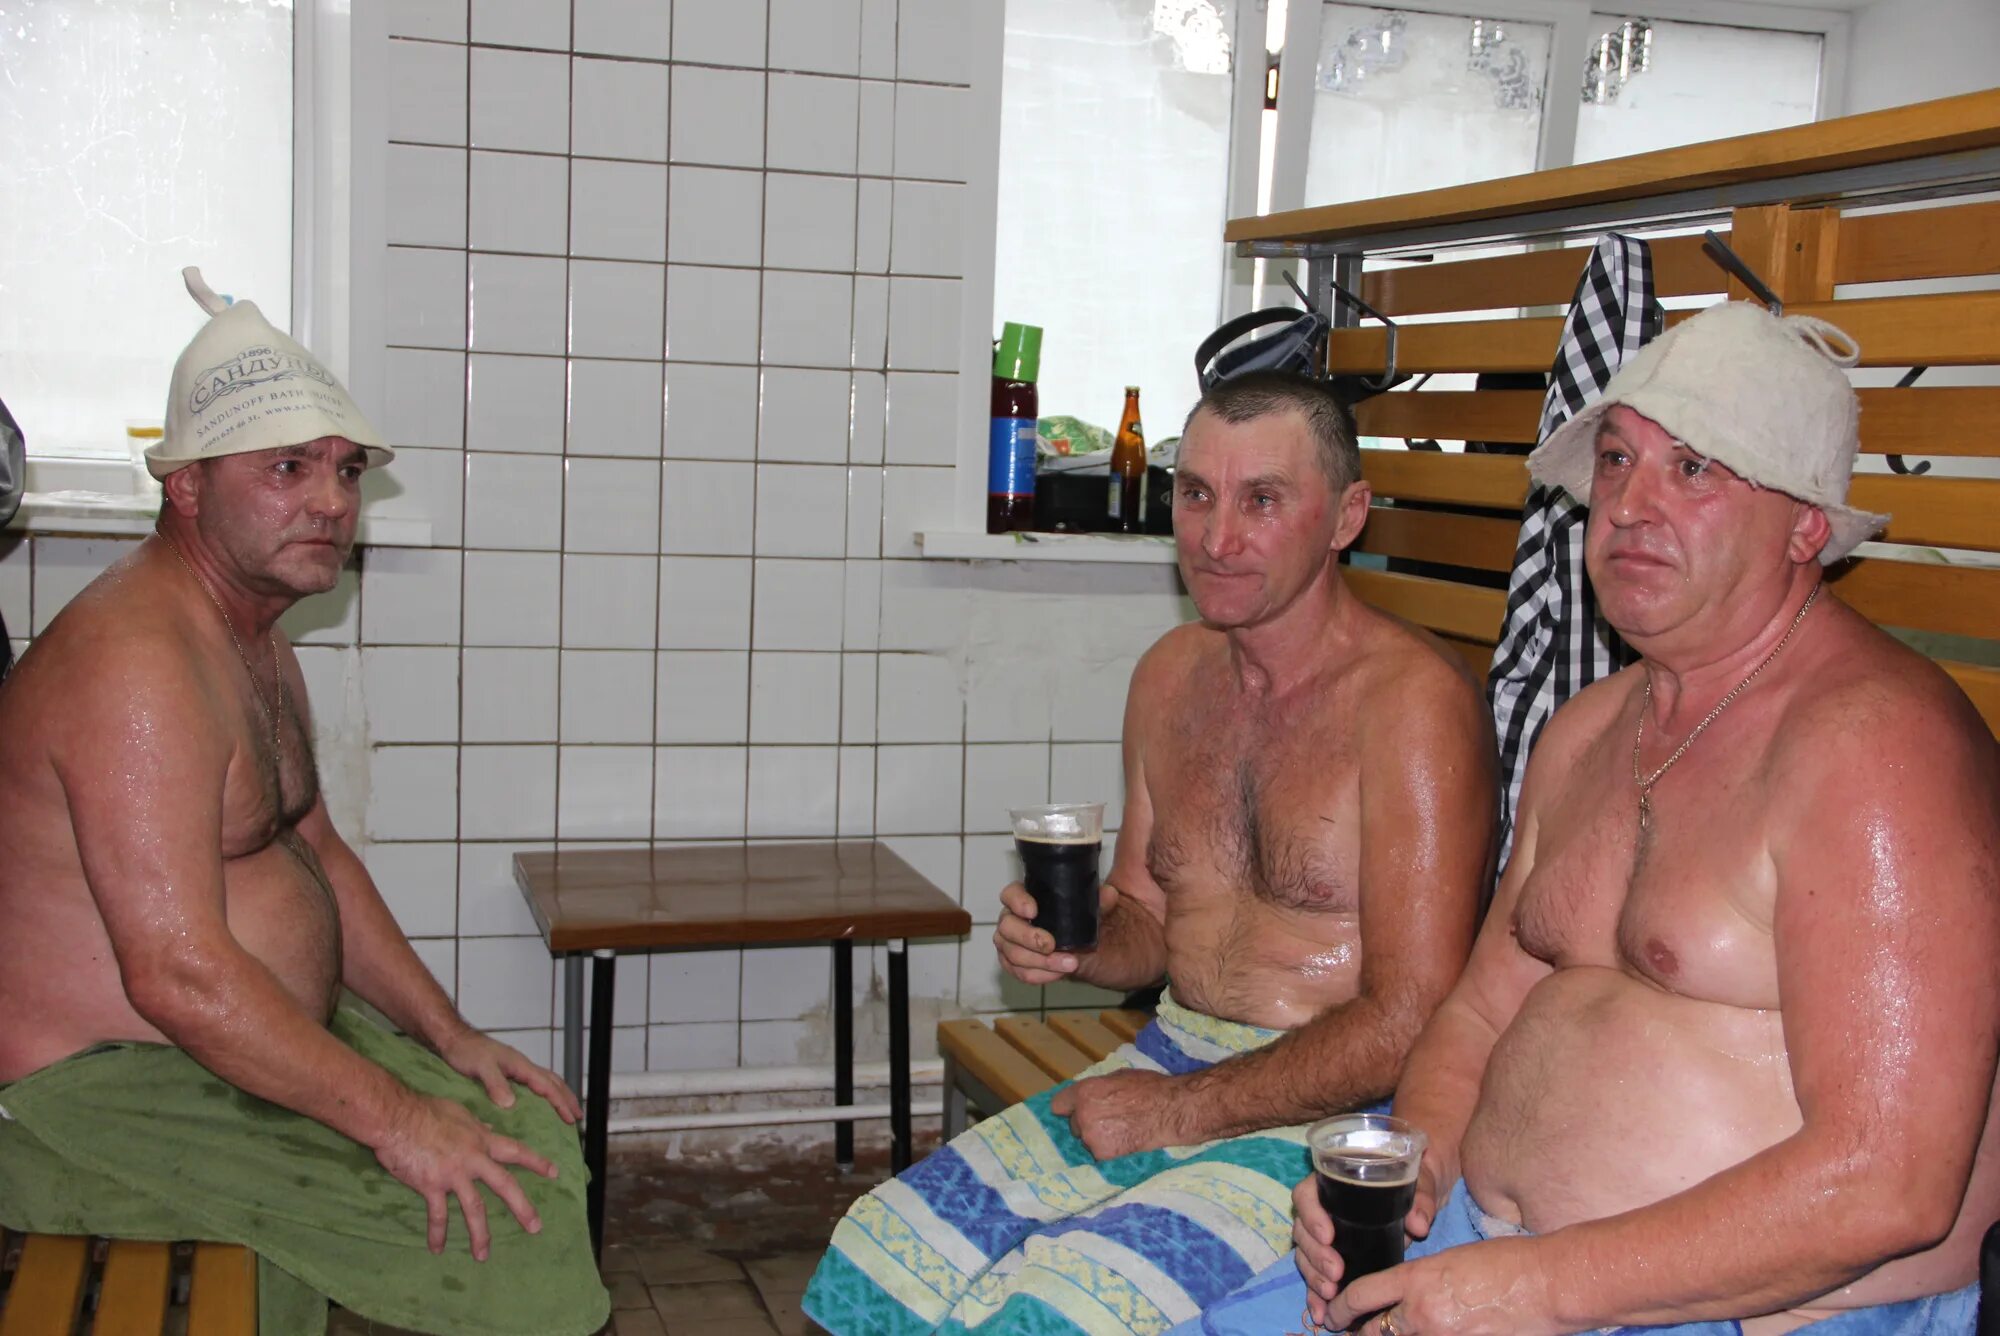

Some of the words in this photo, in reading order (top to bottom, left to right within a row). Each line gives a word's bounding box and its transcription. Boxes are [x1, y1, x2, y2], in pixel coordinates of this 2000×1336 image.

[242, 347, 272, 359] 1896
[194, 356, 330, 404] САНДУНЫ
[196, 395, 265, 438] SANDUNOFF
[270, 389, 304, 402] BATH
